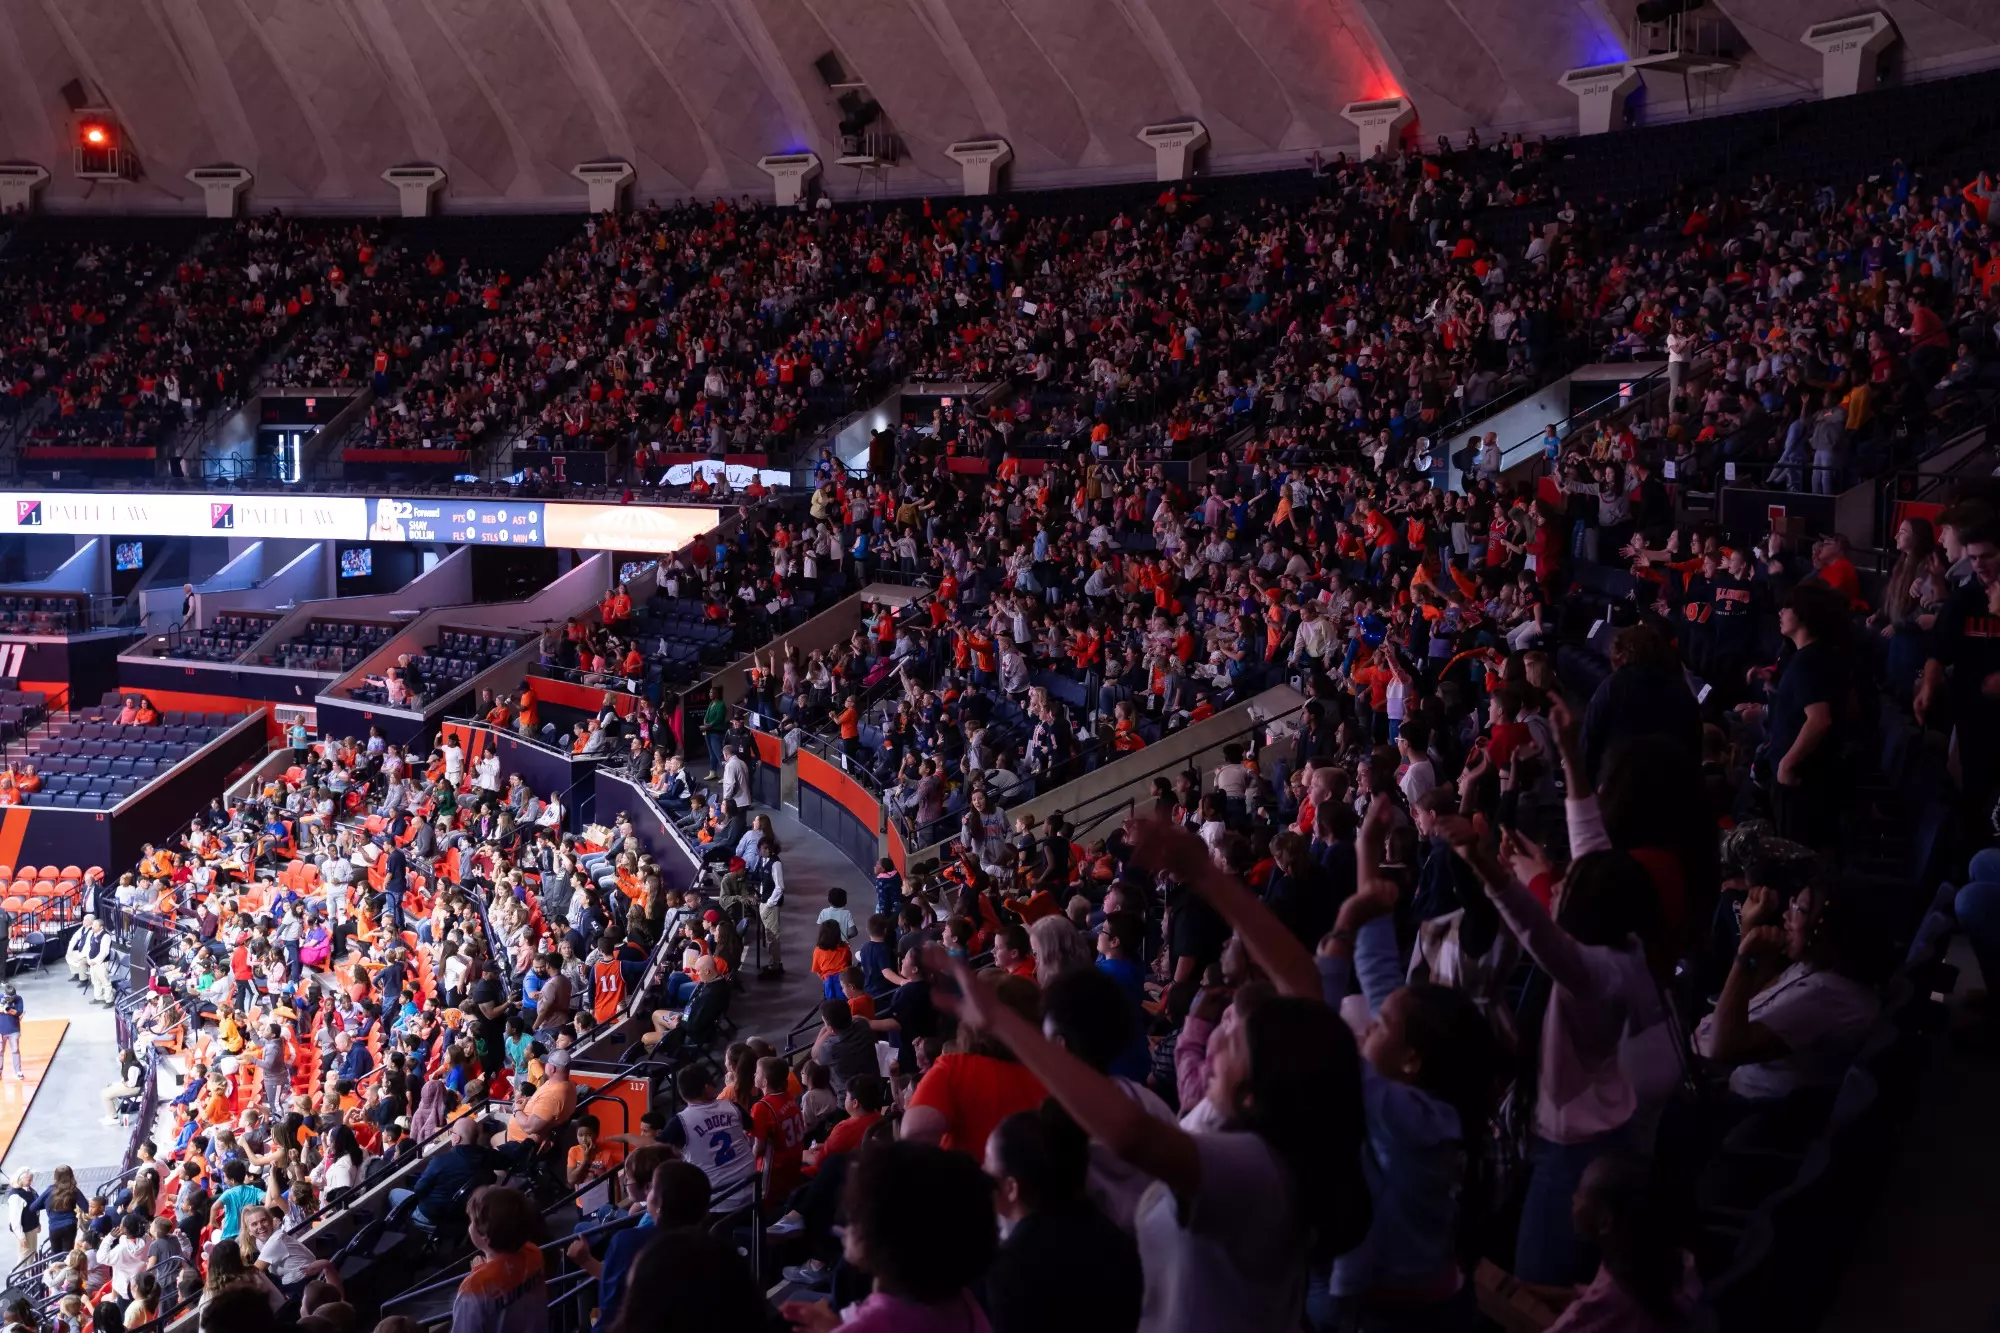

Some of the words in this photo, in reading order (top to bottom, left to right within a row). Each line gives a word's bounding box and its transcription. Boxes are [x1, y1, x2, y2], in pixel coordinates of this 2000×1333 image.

[19, 502, 29, 515] P
[213, 505, 222, 518] P
[392, 502, 412, 519] 22
[414, 507, 440, 518] Forward
[452, 514, 465, 523] PTS
[466, 508, 476, 522] 0
[31, 512, 41, 525] L
[224, 515, 233, 528] L
[482, 515, 496, 524] REB
[497, 509, 507, 523] 0
[512, 516, 527, 525] AST
[528, 511, 537, 524] 0
[409, 520, 428, 531] SHAY
[452, 532, 465, 541] FLS
[466, 527, 476, 540] 0
[481, 533, 499, 542] STLS
[499, 529, 509, 542] 0
[513, 534, 528, 543] MIN
[528, 529, 538, 542] 4
[600, 974, 618, 993] 11
[629, 1082, 645, 1091] 117
[709, 1131, 736, 1167] 2
